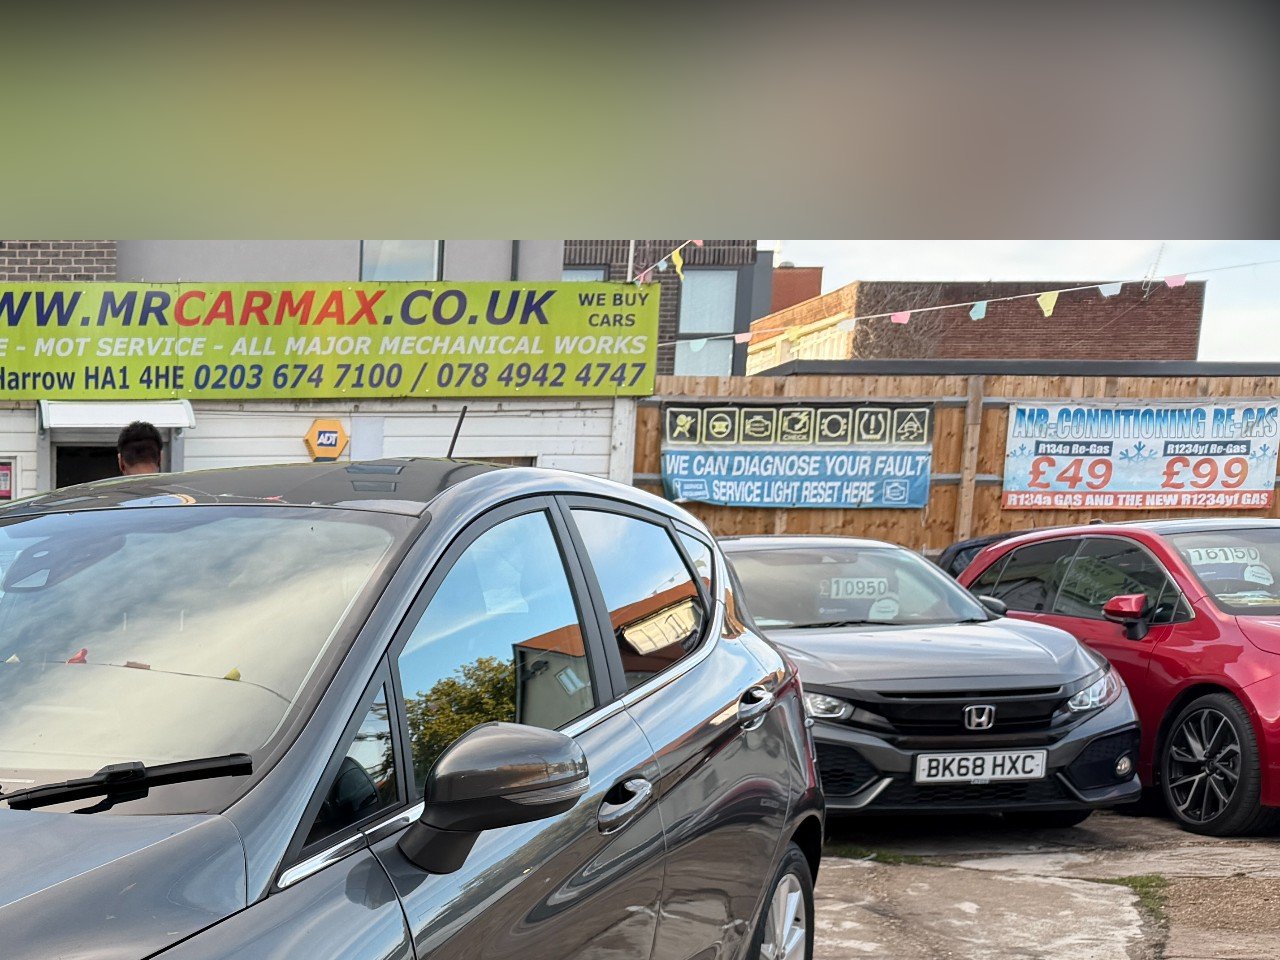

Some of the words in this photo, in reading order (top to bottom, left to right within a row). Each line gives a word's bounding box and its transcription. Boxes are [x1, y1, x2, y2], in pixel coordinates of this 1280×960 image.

[578, 293, 610, 306] WE
[613, 292, 648, 306] BUY
[588, 313, 636, 327] CARS
[33, 337, 87, 357] MOT
[95, 337, 204, 357] SERVICE
[230, 338, 275, 356] ALL
[283, 336, 371, 356] MAJOR
[378, 336, 544, 355] MECHANICAL
[554, 335, 647, 355] WORKS
[85, 365, 129, 390] HA1
[139, 365, 184, 390] 4HE
[194, 364, 261, 389] 0203
[272, 364, 324, 389] 674
[335, 363, 403, 389] 7100
[410, 362, 426, 392] /
[436, 363, 487, 388] 078
[497, 362, 566, 388] 4942
[575, 362, 647, 387] 4747
[1012, 408, 1207, 439] AIR-CONDITIONING
[1212, 407, 1279, 438] RE-GAS
[317, 432, 338, 445] ADT
[1039, 443, 1070, 454] R134a
[1071, 443, 1110, 454] Re-Gas
[1167, 444, 1210, 455] R1234yf
[1210, 444, 1247, 454] Re-Gas
[666, 454, 690, 475] WE
[693, 455, 728, 475] CAN
[732, 455, 820, 476] DIAGNOSE
[826, 455, 872, 476] YOUR
[874, 455, 925, 475] FAULT
[1027, 456, 1113, 490] £49
[1161, 456, 1249, 489] £99
[712, 480, 763, 502] SERVICE
[764, 481, 799, 502] LIGHT
[802, 482, 842, 502] RESET
[842, 481, 875, 502] HERE
[1007, 494, 1052, 506] R134a
[1053, 494, 1082, 506] GAS
[1085, 494, 1114, 506] AND
[1117, 494, 1143, 506] THE
[1145, 494, 1179, 506] NEW
[1181, 494, 1241, 507] R1234yf
[1241, 493, 1269, 505] GAS
[927, 756, 985, 778] BK68
[991, 755, 1035, 775] HXC
